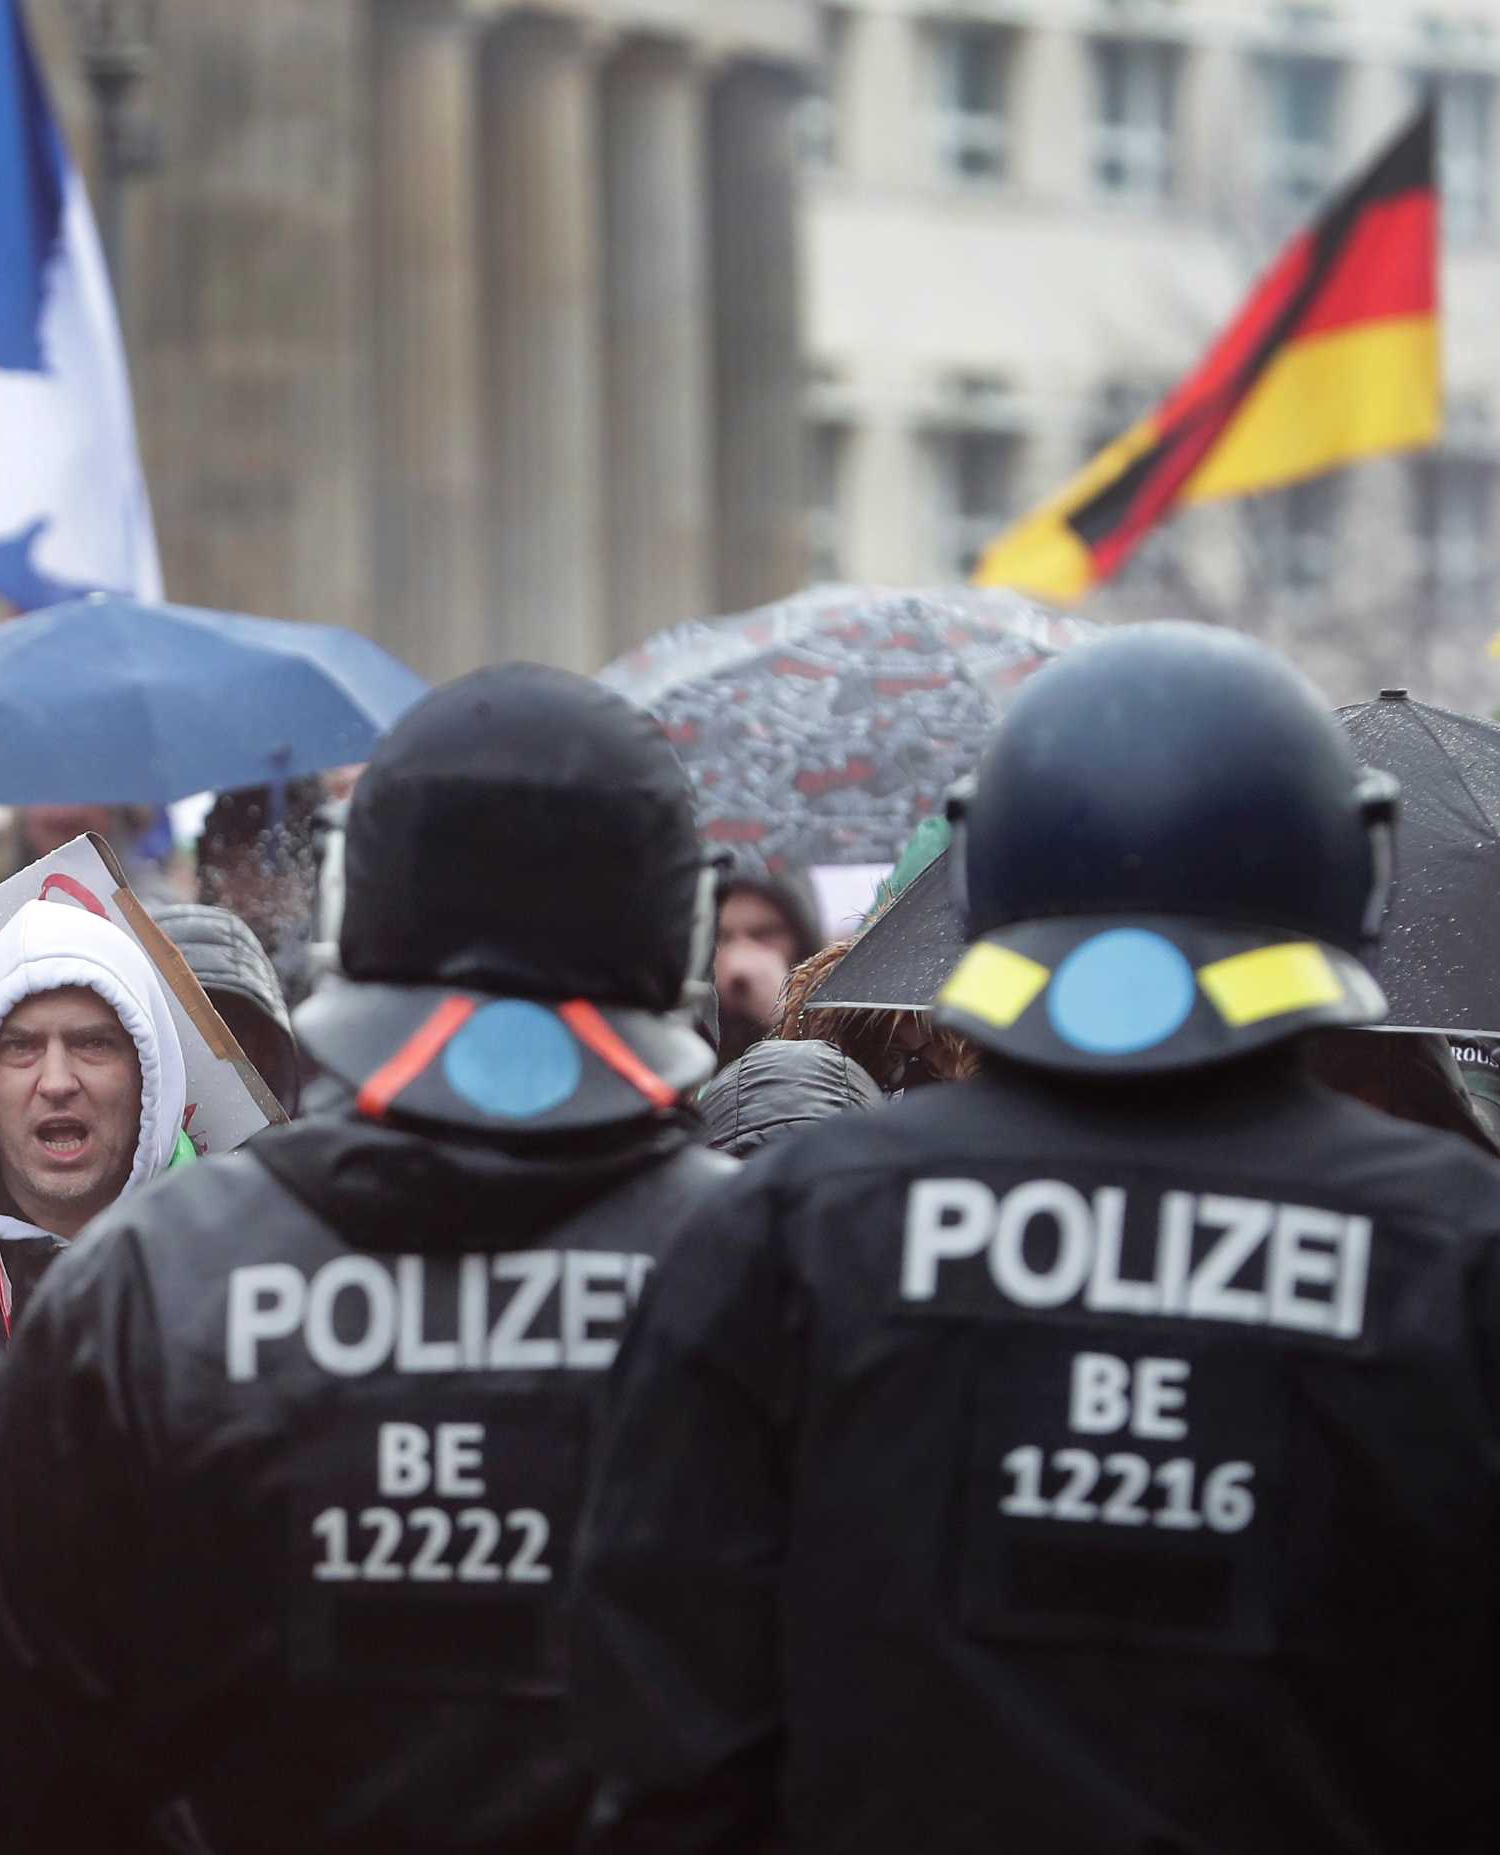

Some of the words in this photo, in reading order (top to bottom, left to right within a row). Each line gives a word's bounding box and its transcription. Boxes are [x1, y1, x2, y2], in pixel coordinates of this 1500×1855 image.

[902, 1177, 1372, 1338] POLIZEI
[1070, 1352, 1189, 1439] BE
[378, 1422, 485, 1496] BE
[1001, 1445, 1254, 1532] 12216
[312, 1507, 551, 1582] 12222
